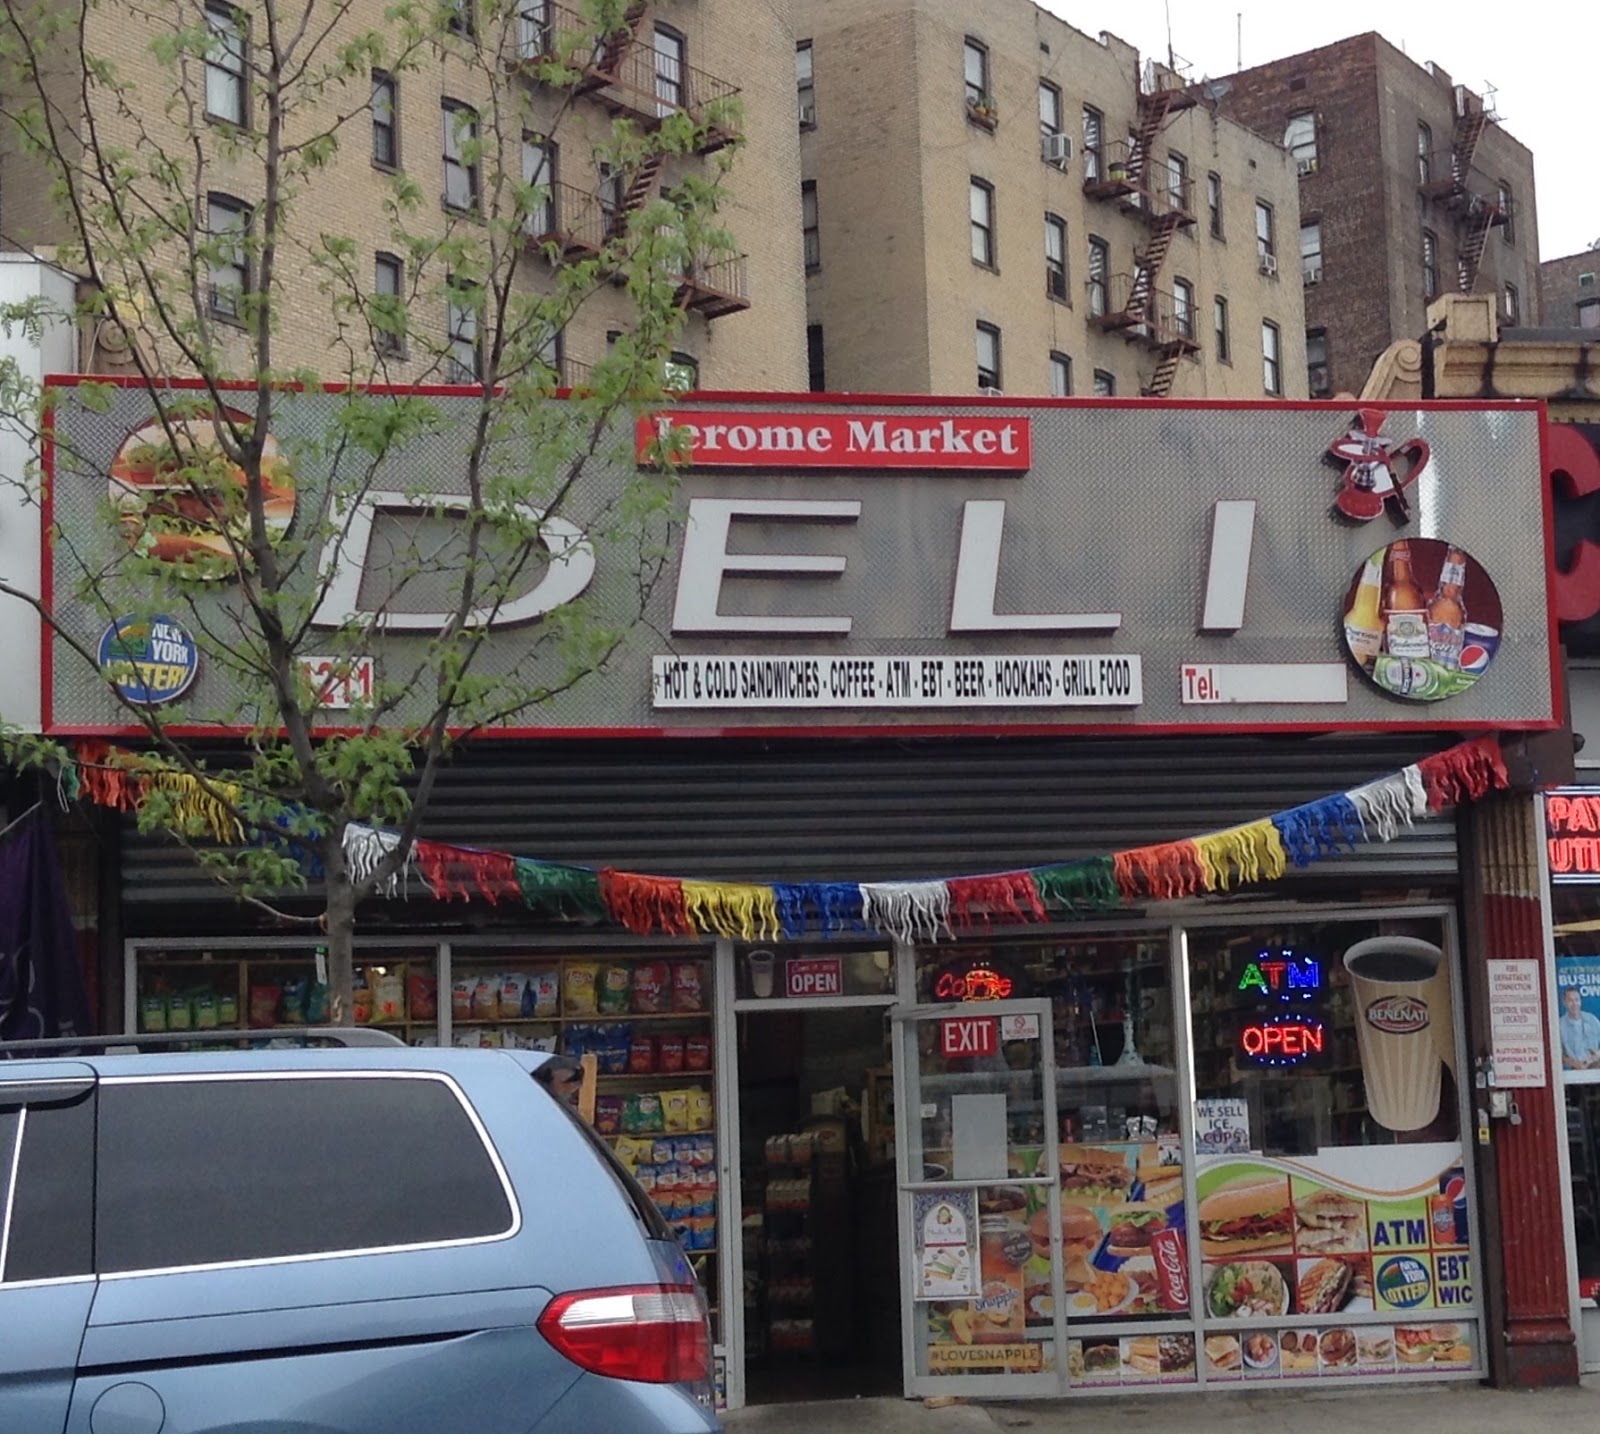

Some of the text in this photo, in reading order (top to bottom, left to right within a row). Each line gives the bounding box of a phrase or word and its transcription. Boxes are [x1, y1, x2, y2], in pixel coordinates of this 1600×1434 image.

[655, 416, 1019, 455] Jerome Market
[310, 490, 1258, 632] DELI
[152, 623, 184, 643] NEW
[152, 639, 189, 664] YORK
[107, 659, 189, 691] TERY
[664, 659, 1131, 699] HOT & COLD SANDWICHES COFFEE ATM EBT BEER HOOKAHS GRILL FOOD
[1185, 669, 1219, 700] Tel.
[791, 973, 837, 993] OPEN
[936, 971, 1012, 997] Coe
[1238, 962, 1319, 990] ATM
[944, 1021, 992, 1052] EXIT
[1243, 1026, 1322, 1053] OPEN
[1197, 1106, 1243, 1118] WE SELL
[1373, 1219, 1426, 1246] ATM
[1404, 1269, 1426, 1283] YORK
[1436, 1254, 1469, 1281] EBT
[1438, 1285, 1473, 1304] WIC
[931, 1349, 1037, 1361] #LOVESNAPPLE
